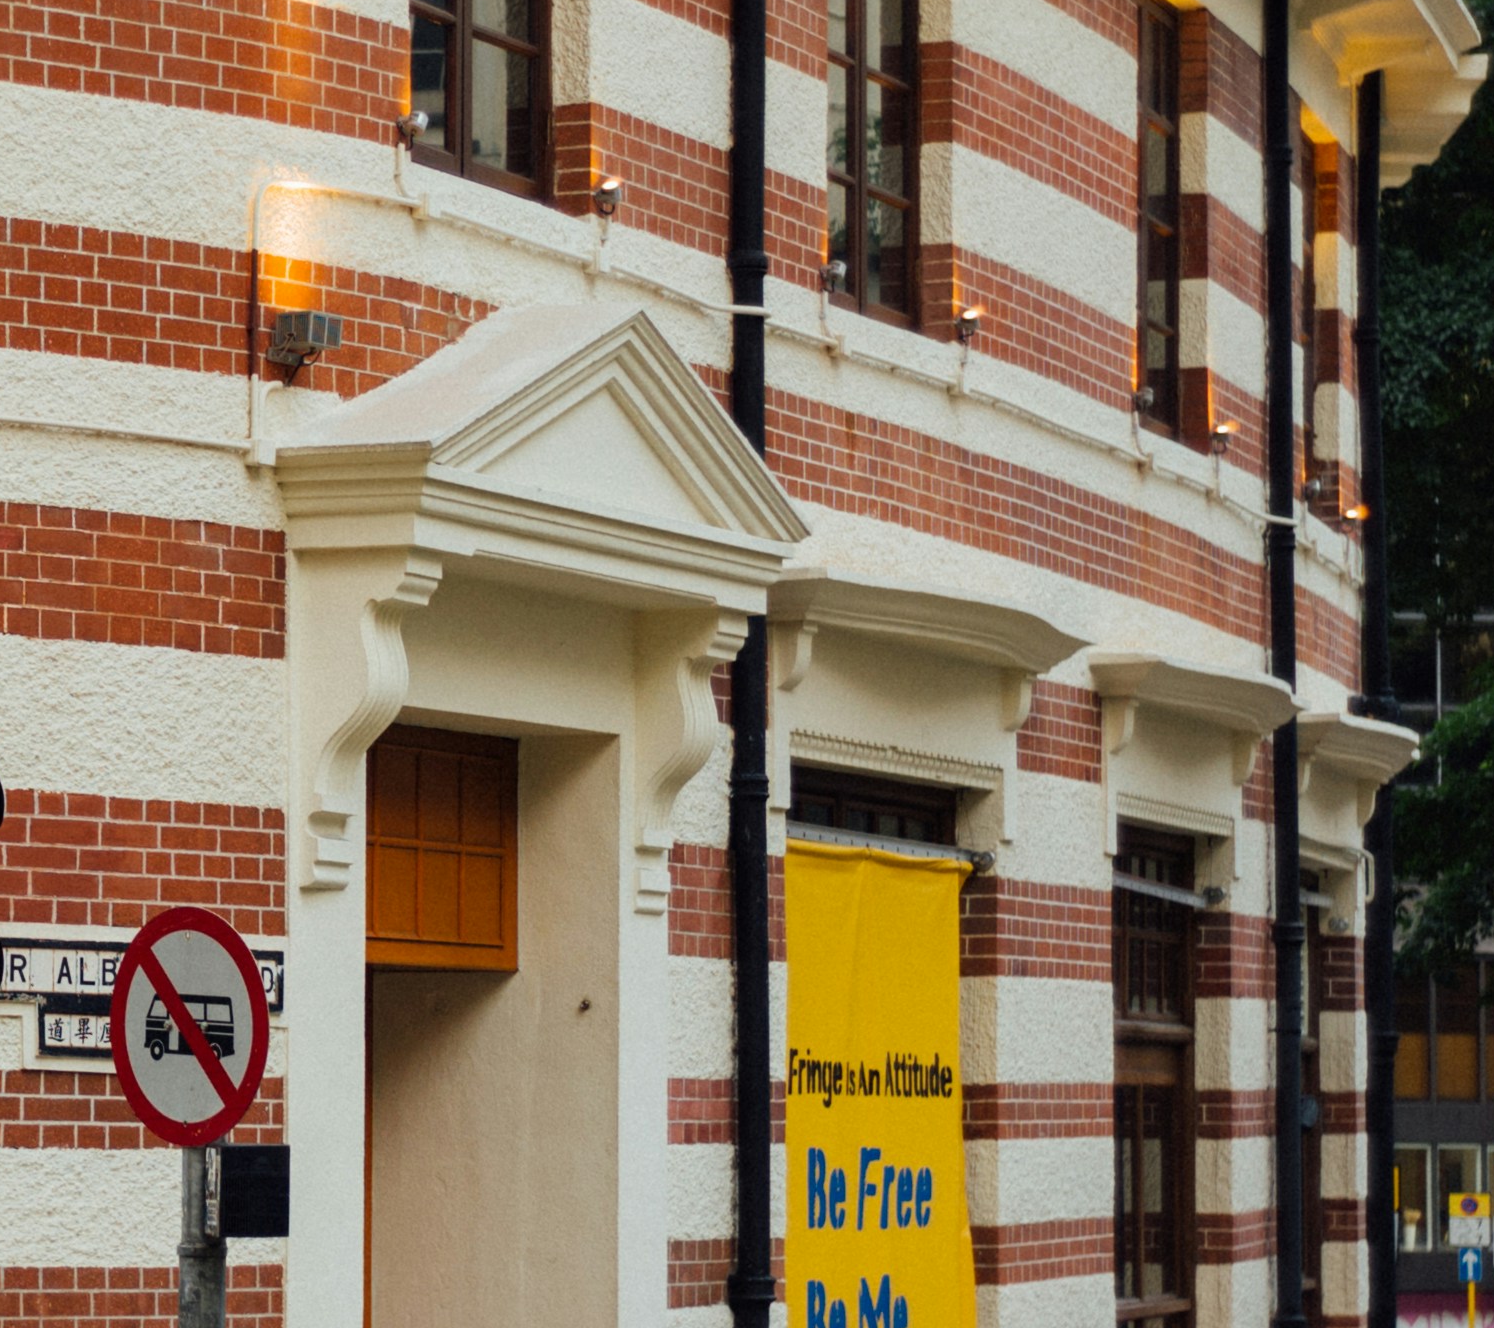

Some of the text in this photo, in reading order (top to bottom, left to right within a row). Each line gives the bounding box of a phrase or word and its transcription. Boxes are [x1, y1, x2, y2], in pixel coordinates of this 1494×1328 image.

[56, 956, 118, 986] ALB
[787, 1048, 953, 1109] Fringe Is An Attitude
[807, 1147, 933, 1231] Be Free
